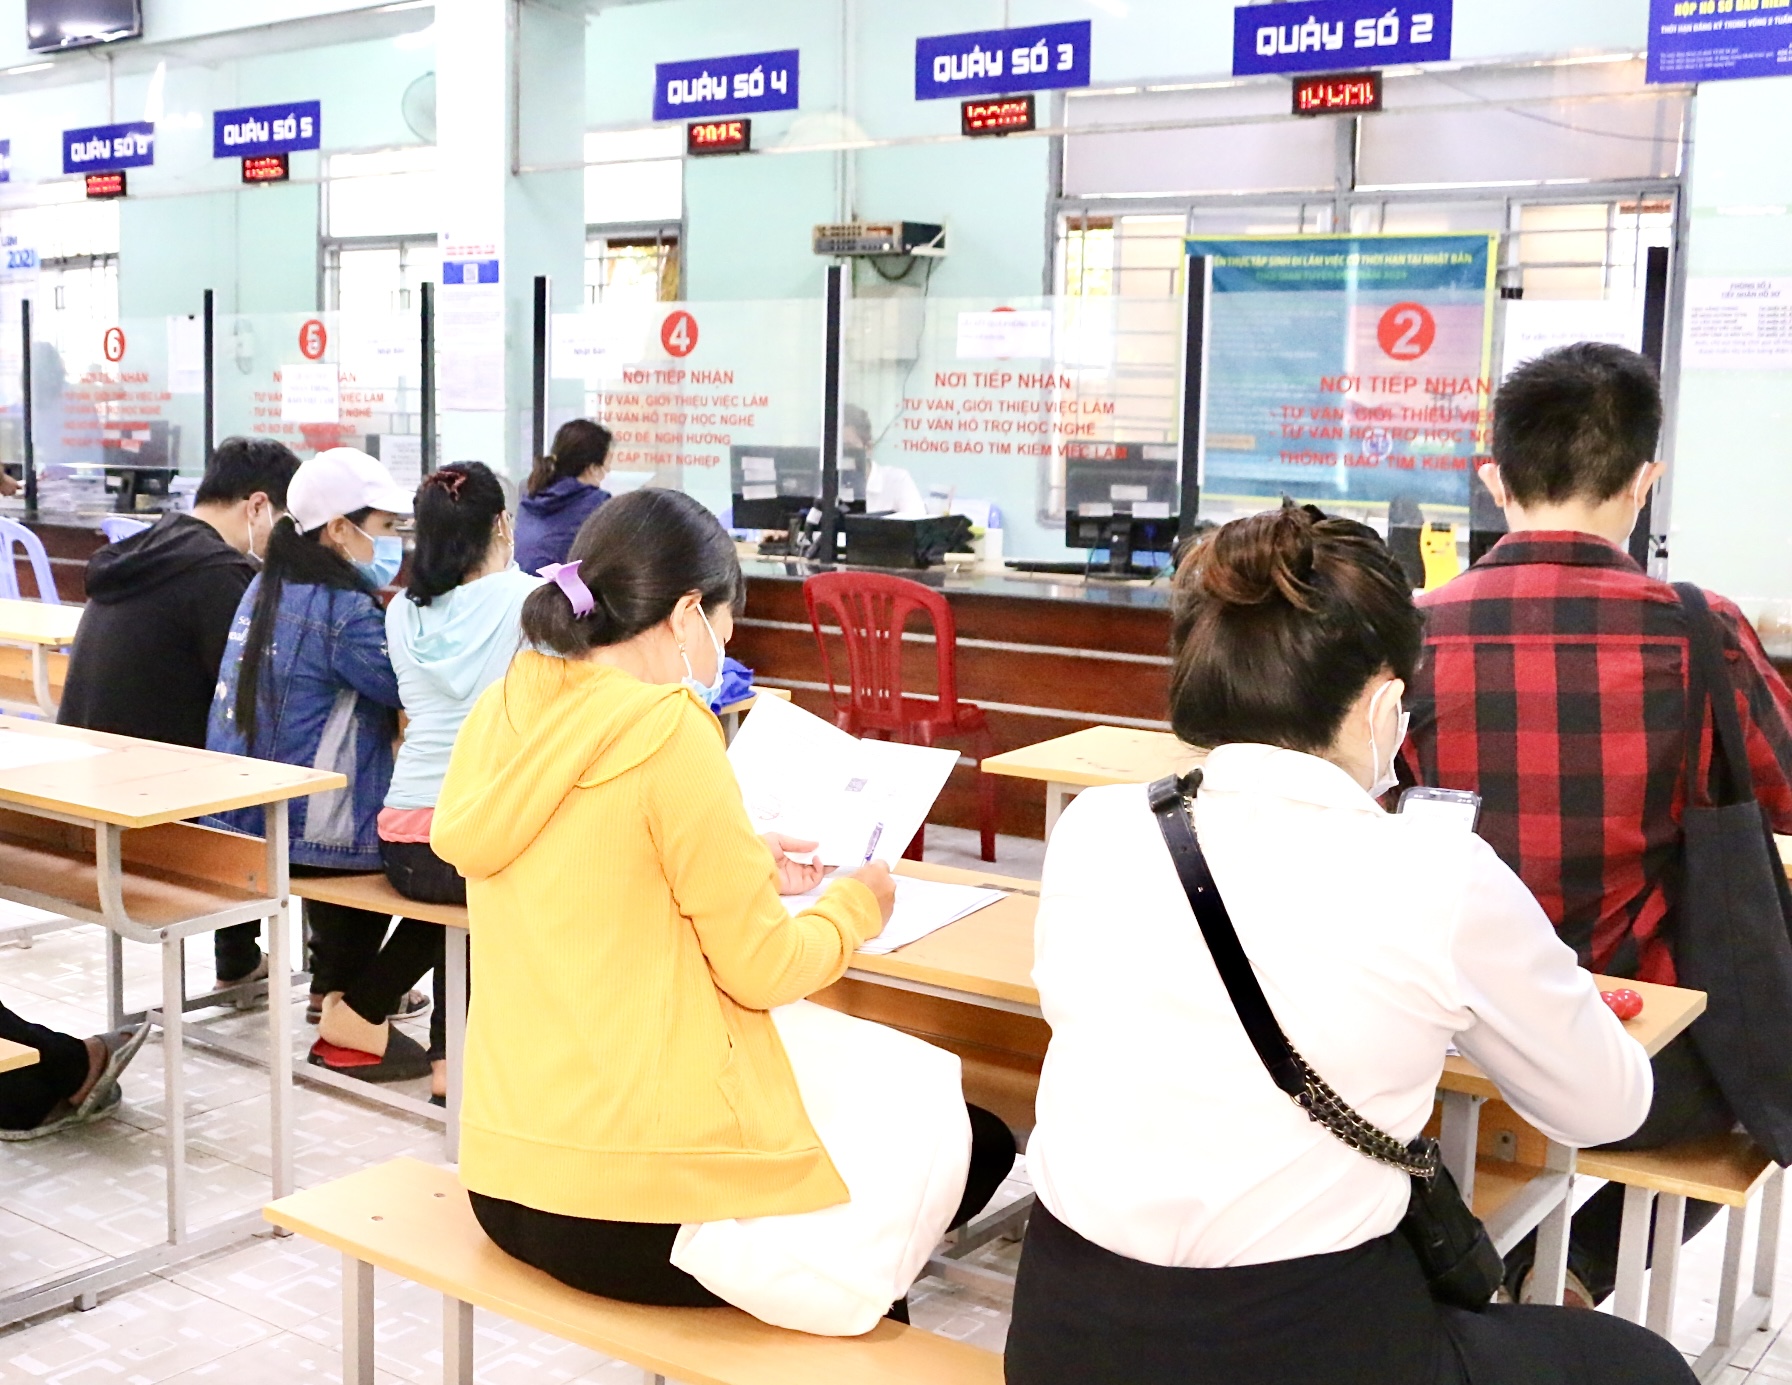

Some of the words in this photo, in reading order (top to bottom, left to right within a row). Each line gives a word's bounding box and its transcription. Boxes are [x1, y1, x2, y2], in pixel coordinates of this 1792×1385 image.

[1354, 7, 1400, 48] SỐ
[1410, 13, 1434, 43] 2
[1012, 38, 1049, 75] SỐ
[1057, 43, 1073, 71] 3
[733, 65, 765, 99] SỐ
[771, 69, 787, 95] 4
[273, 112, 297, 141] SỐ
[300, 116, 313, 138] 5
[692, 122, 742, 143] 2015
[113, 132, 134, 158] SỐ
[107, 329, 121, 361] 6
[306, 324, 320, 355] 5
[669, 316, 691, 352] 4
[1391, 309, 1423, 354] 2
[934, 371, 967, 387] NƠI
[973, 368, 1012, 388] TIẾP
[1320, 375, 1361, 393] NƠI
[1017, 420, 1048, 437] HỌC
